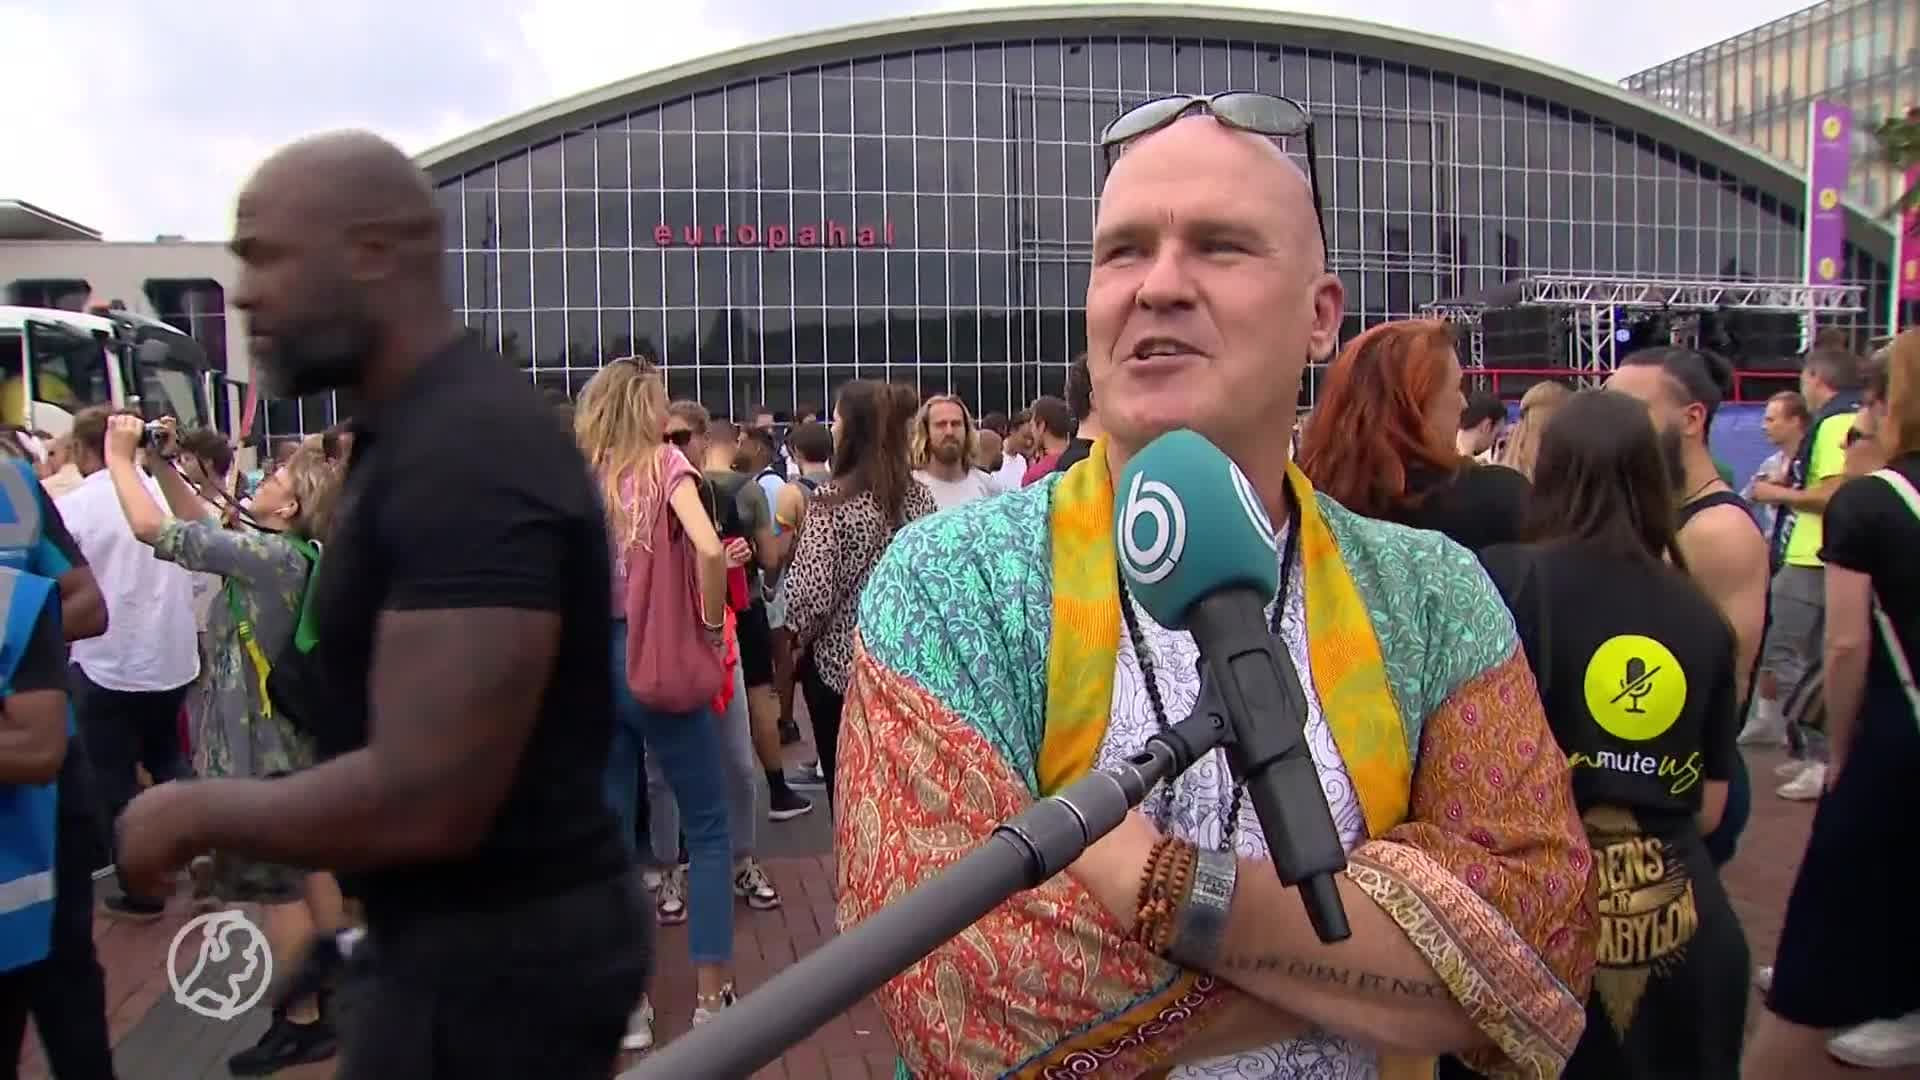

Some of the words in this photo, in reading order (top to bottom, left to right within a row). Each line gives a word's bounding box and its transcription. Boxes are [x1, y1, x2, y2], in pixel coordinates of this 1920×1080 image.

[654, 219, 896, 252] europahal
[1593, 837, 1665, 896] DENS
[1597, 879, 1698, 963] ABYLON
